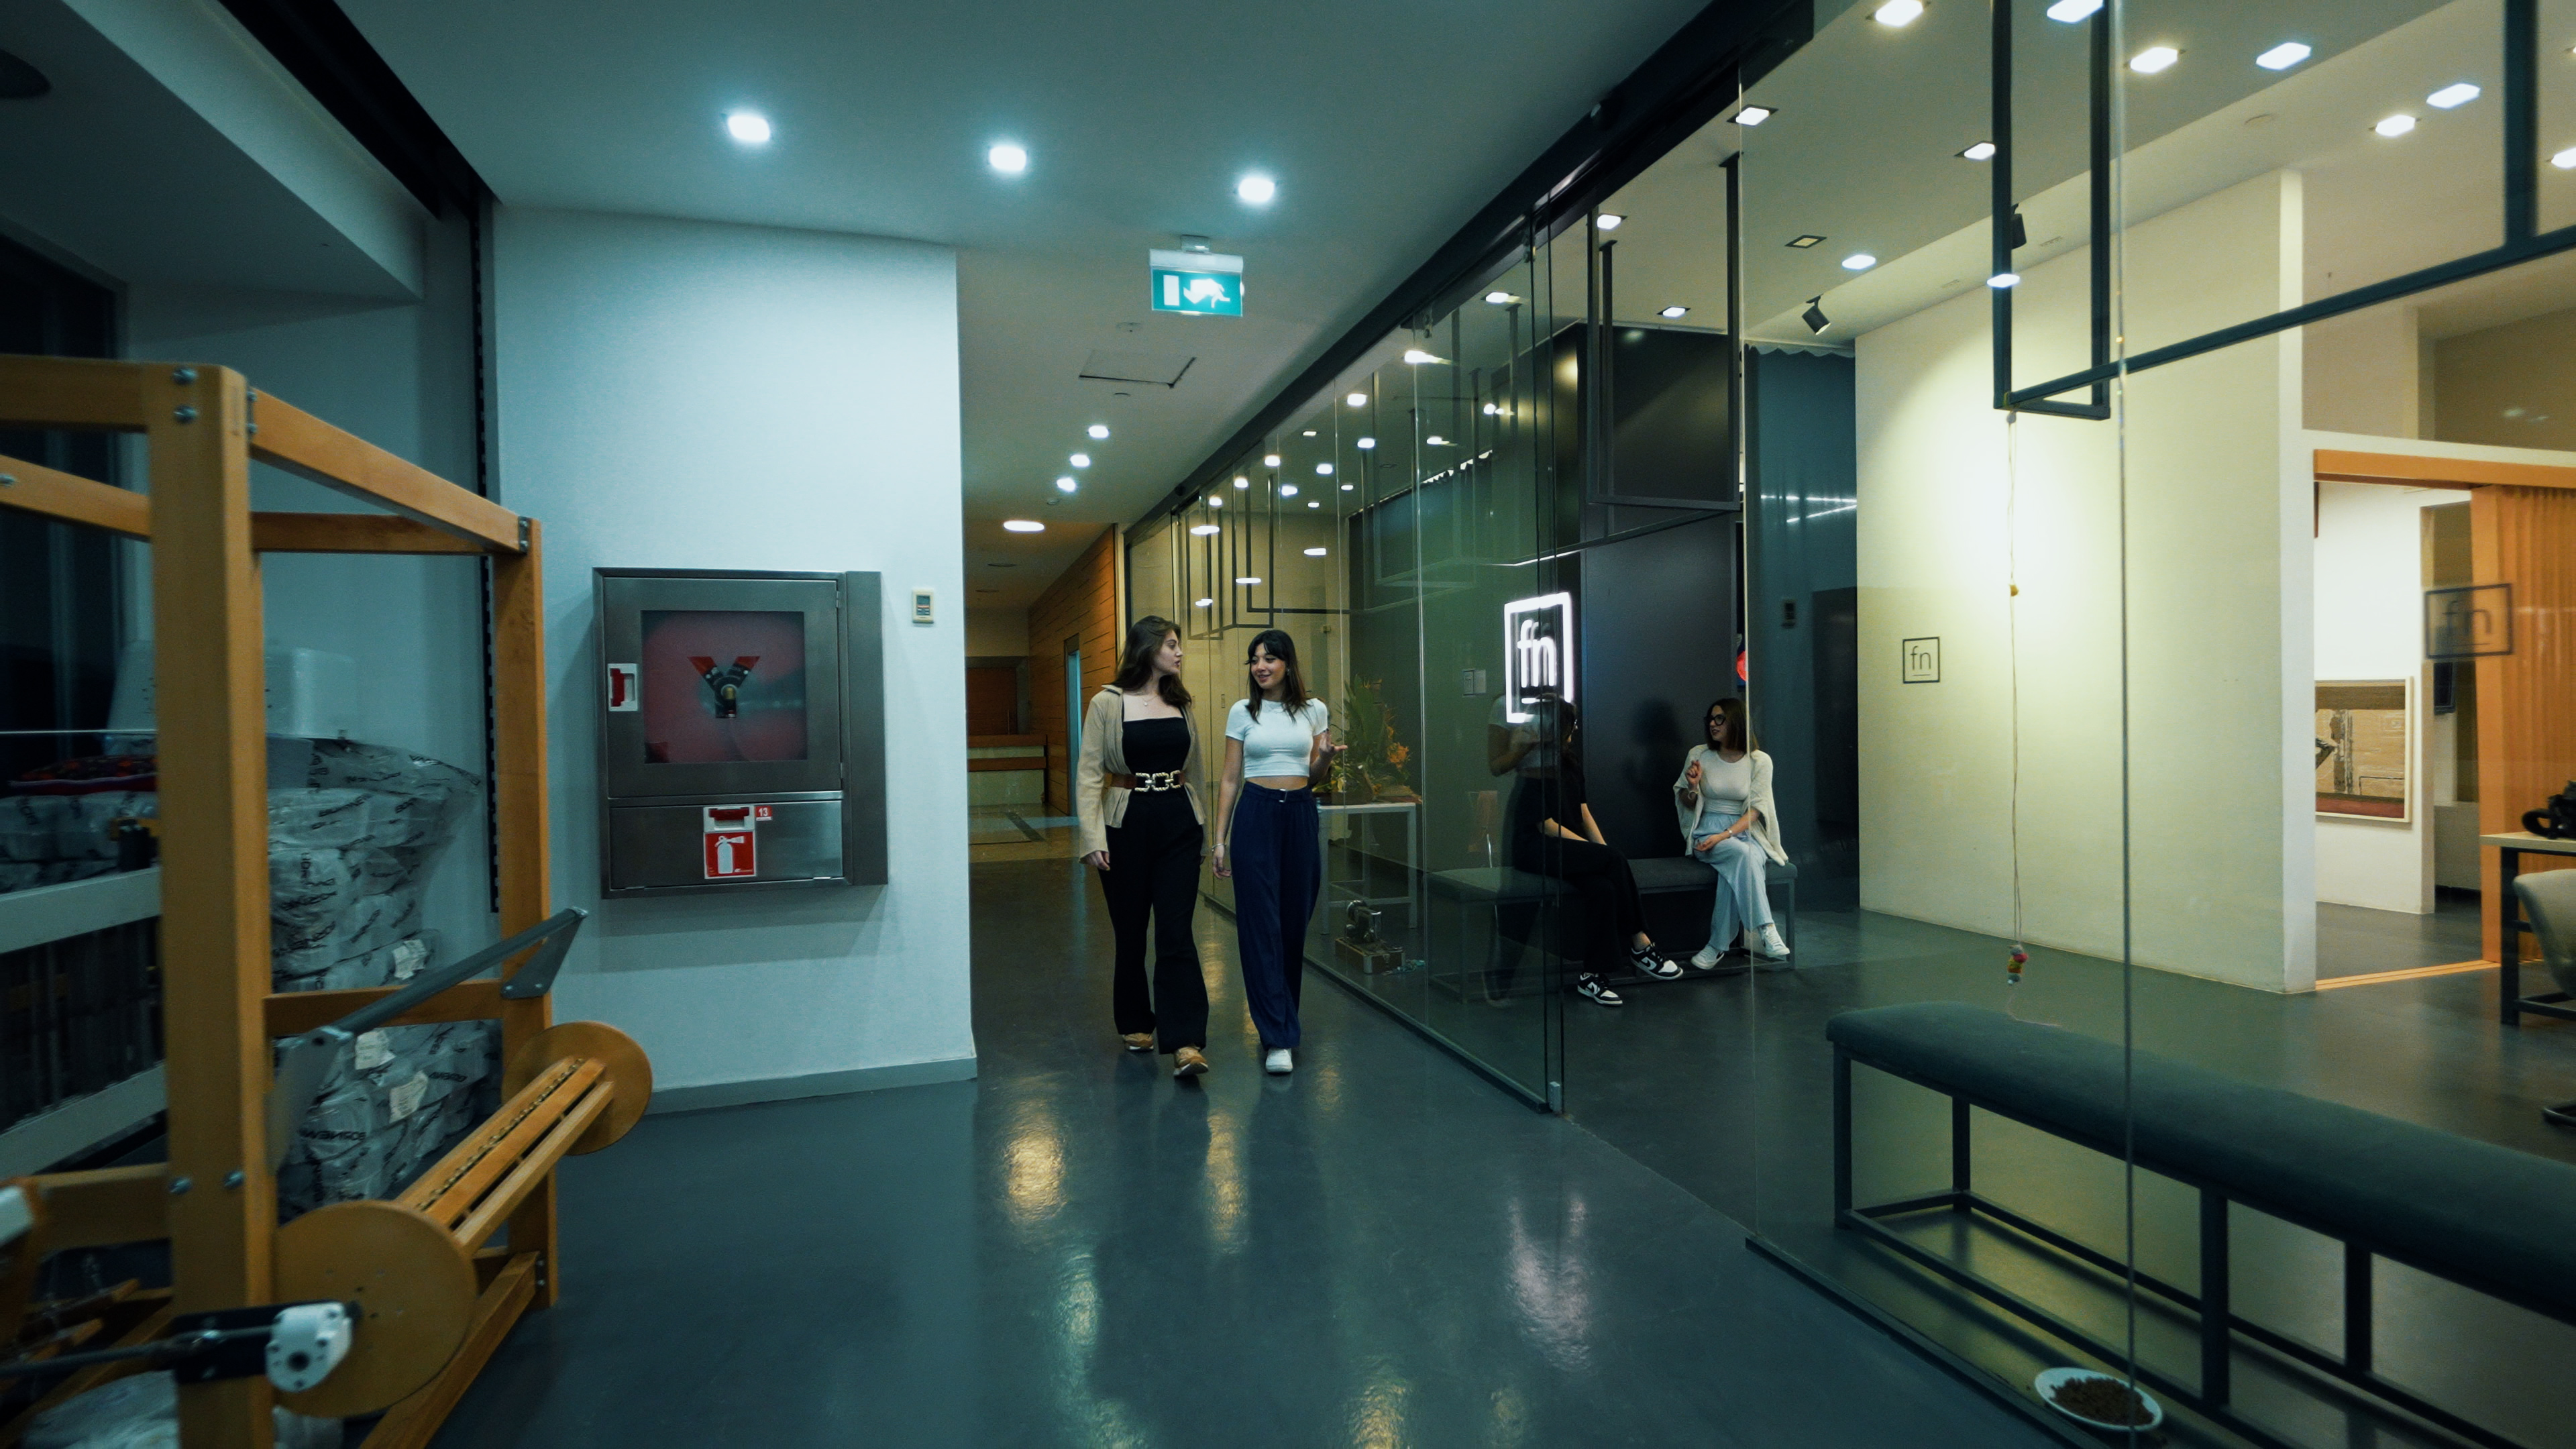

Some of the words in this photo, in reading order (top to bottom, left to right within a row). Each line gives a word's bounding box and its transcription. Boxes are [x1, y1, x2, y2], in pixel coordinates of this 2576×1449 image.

[2442, 601, 2491, 635] fn
[1517, 619, 1556, 688] fn
[1911, 645, 1931, 669] fn
[758, 808, 768, 816] 13
